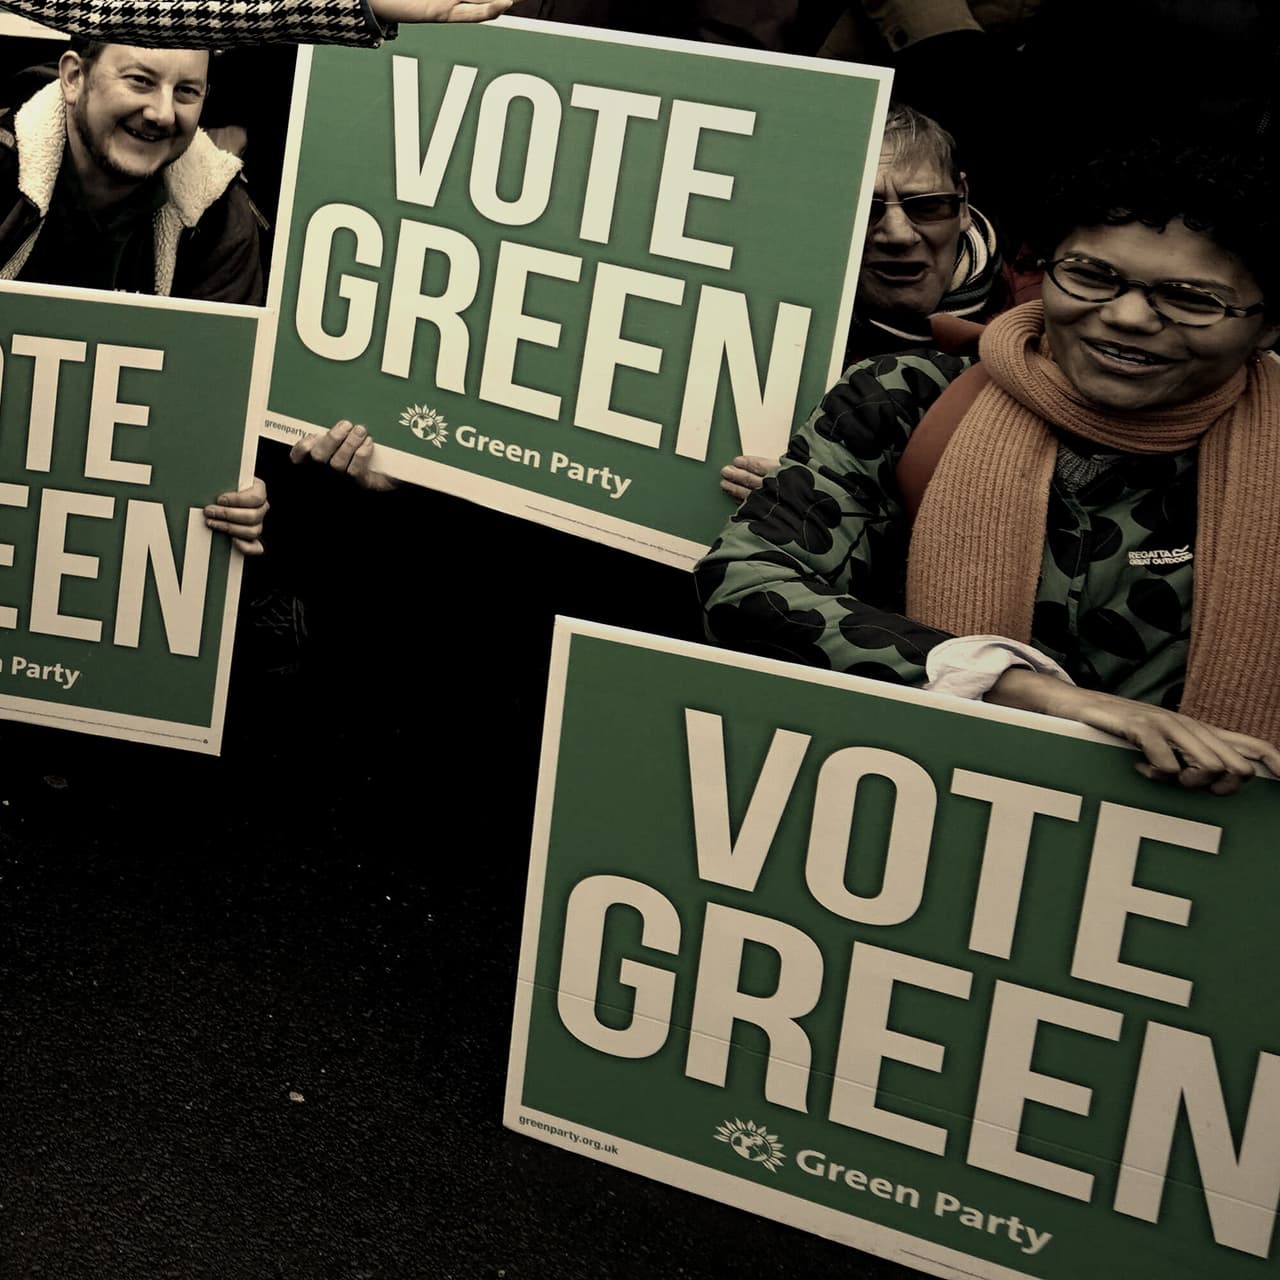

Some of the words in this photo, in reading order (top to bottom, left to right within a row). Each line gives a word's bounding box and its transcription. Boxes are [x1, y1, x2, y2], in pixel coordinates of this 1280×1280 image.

[391, 54, 756, 271] VOTE
[295, 202, 812, 464] GREEN
[455, 424, 542, 469] Green
[550, 452, 633, 500] Party
[1128, 550, 1172, 559] REGATTA
[12, 656, 80, 690] Party
[685, 707, 1223, 1008] VOTE
[557, 874, 1280, 1260] GREEN
[519, 1115, 619, 1155] greenparty.org.uk
[795, 1148, 921, 1208] Green
[935, 1192, 1053, 1255] Party
